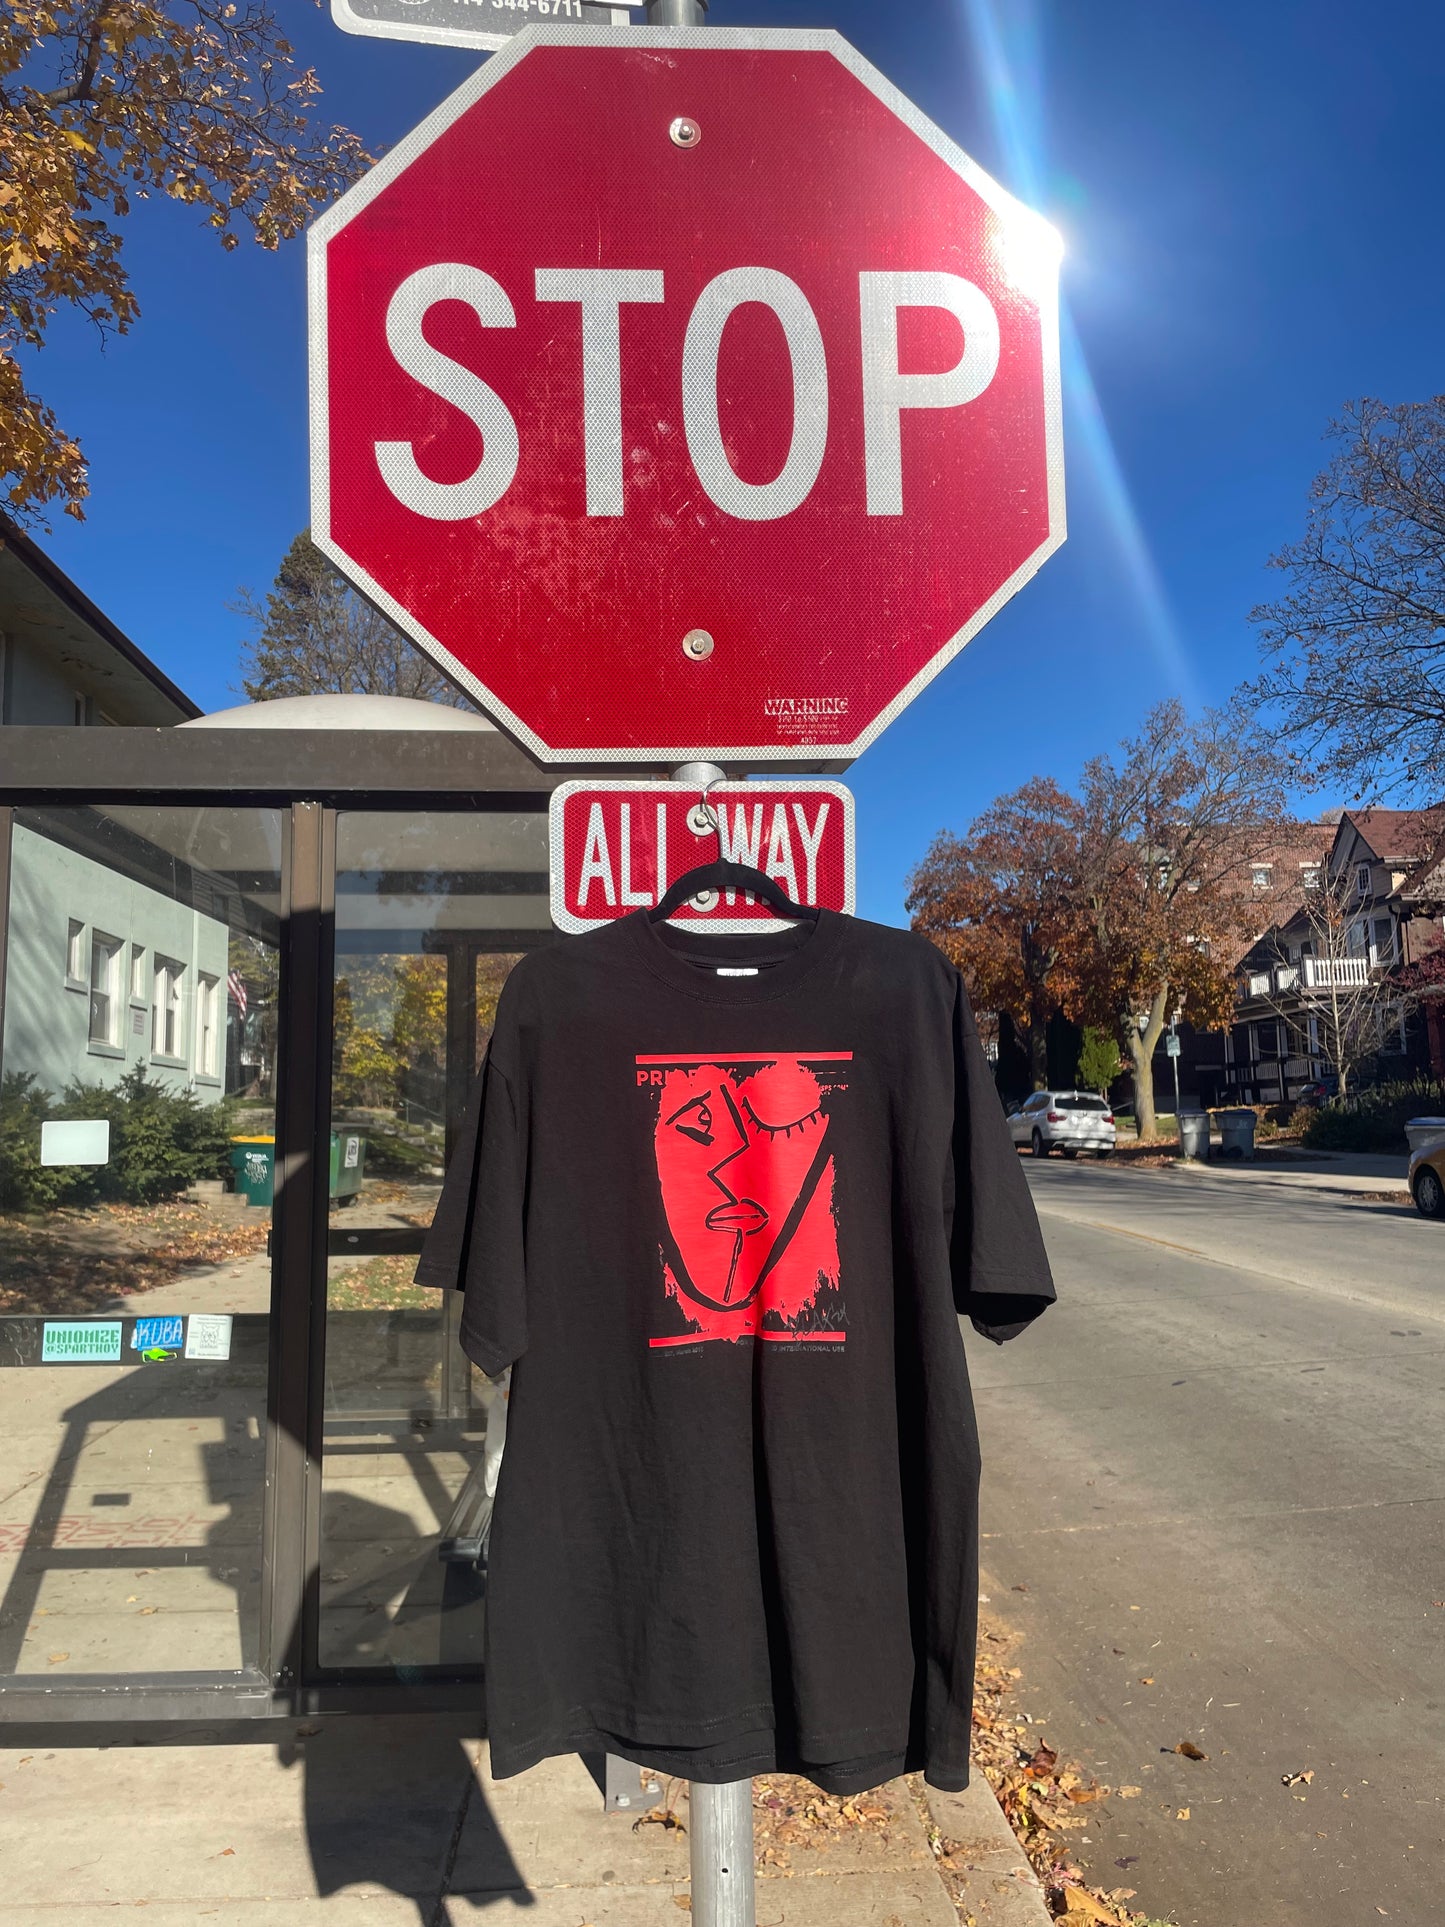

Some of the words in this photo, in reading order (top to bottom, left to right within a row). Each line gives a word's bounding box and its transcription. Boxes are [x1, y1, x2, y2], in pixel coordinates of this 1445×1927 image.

[374, 262, 1000, 521] STOP
[764, 698, 848, 715] WARNING
[717, 802, 830, 906] WAY
[46, 1329, 119, 1344] UNIONIZE
[138, 1319, 183, 1347] KUBA
